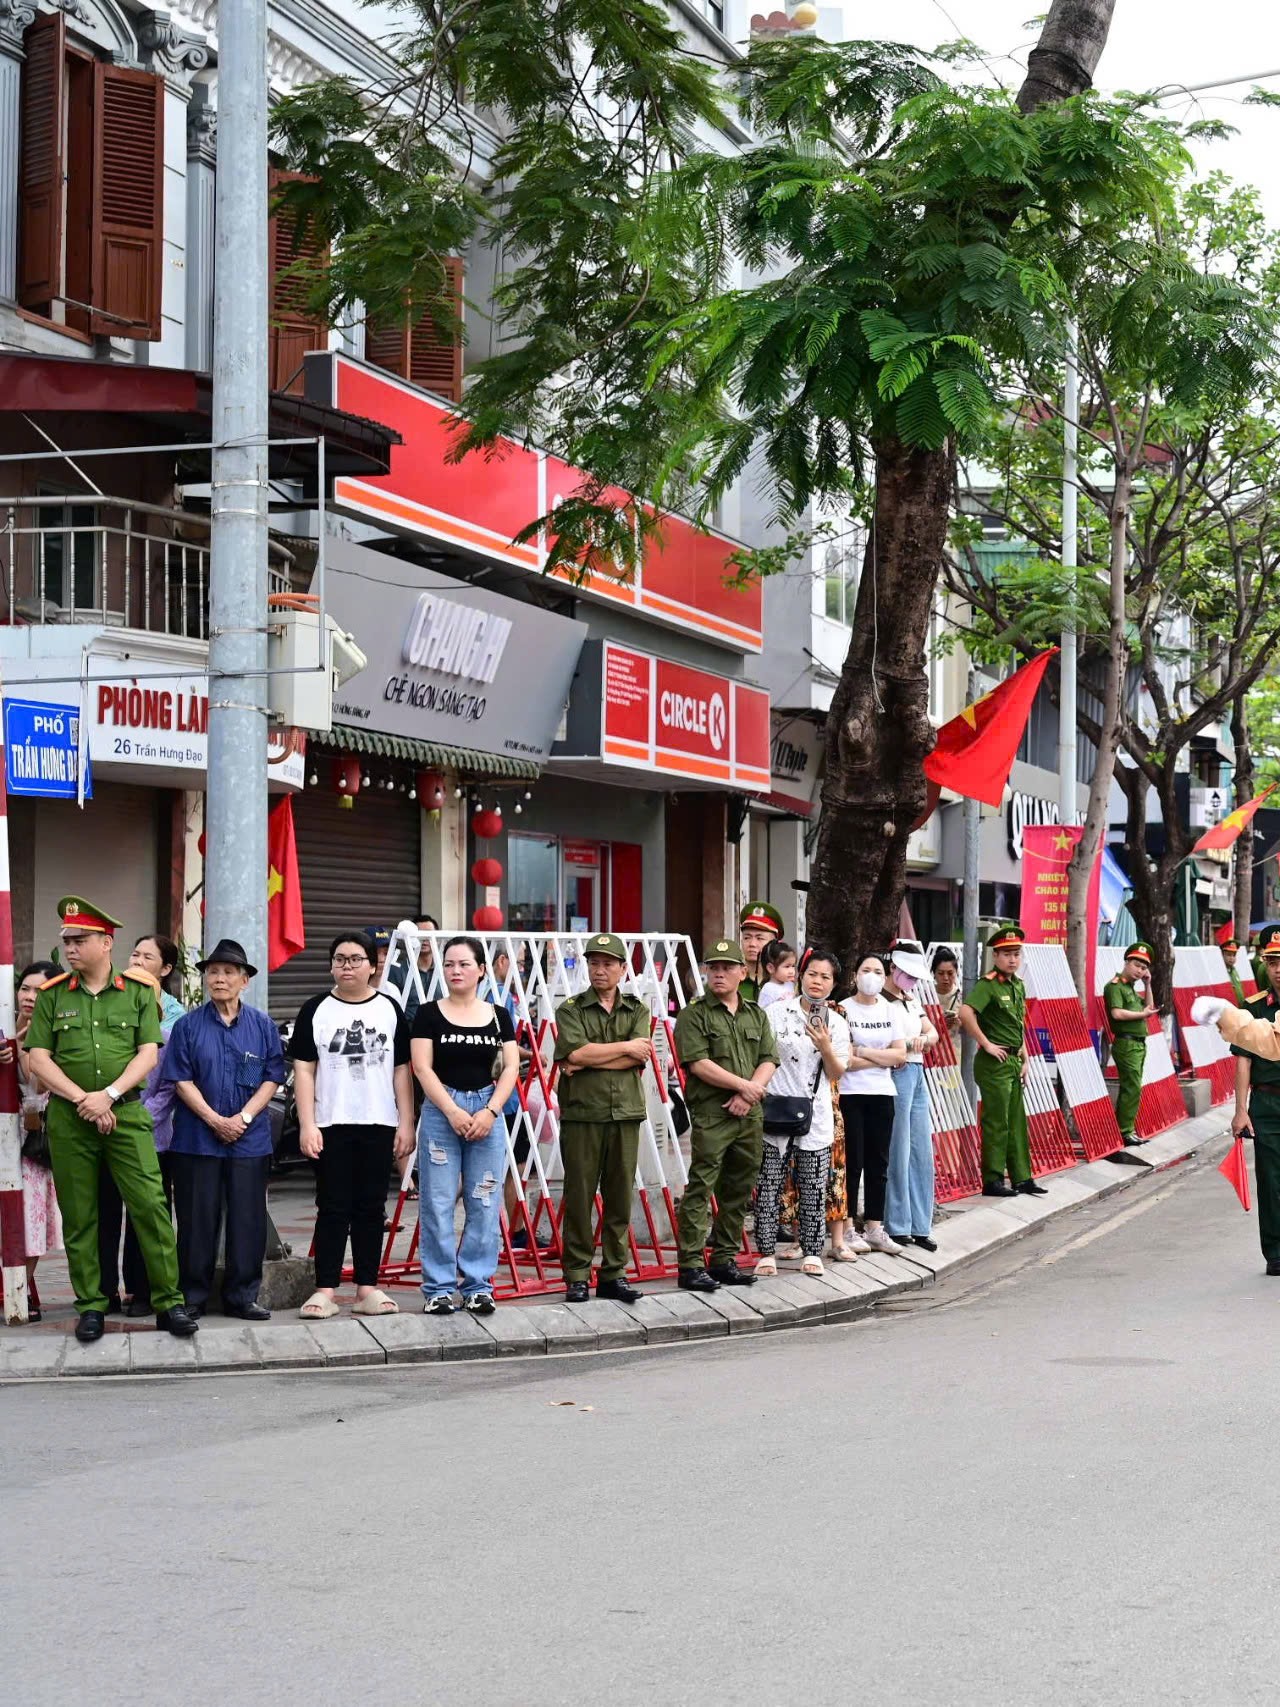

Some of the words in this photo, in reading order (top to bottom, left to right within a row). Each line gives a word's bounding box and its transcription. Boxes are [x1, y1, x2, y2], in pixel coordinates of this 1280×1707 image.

[97, 678, 172, 730] PHÒNG
[407, 681, 440, 710] NGON
[436, 685, 467, 716] SÁNG
[466, 695, 487, 723] TẠO
[34, 712, 64, 735] PHỐ
[660, 690, 706, 735] CIRCLE
[711, 699, 726, 747] K
[11, 735, 39, 779] TRẦN
[40, 745, 66, 782] HƯNG
[114, 738, 131, 754] 26
[135, 743, 157, 757] Trần
[160, 746, 183, 763] Hưng
[186, 748, 203, 764] Đạo
[1044, 902, 1058, 912] 135
[1040, 917, 1060, 930] NGÀY
[860, 1021, 892, 1029] SANDER
